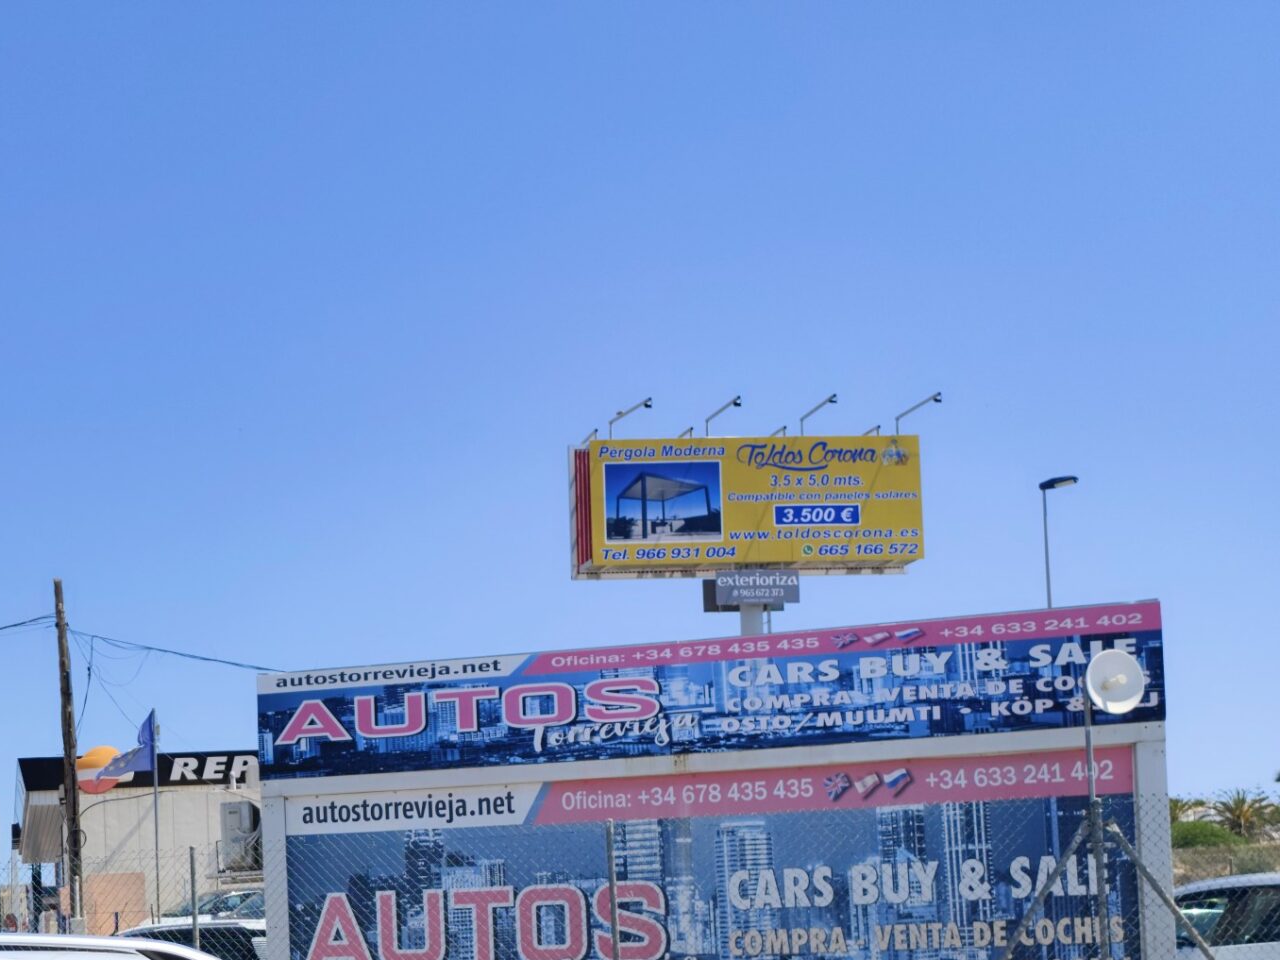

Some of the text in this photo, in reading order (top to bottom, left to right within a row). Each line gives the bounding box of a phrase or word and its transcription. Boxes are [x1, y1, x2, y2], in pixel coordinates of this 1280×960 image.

[598, 445, 725, 460] Pergola Moderna
[808, 441, 877, 464] Corona
[795, 476, 804, 486] x
[833, 475, 864, 486] mts.
[727, 490, 918, 502] Compatible con paneles solares
[782, 507, 853, 523] 3.500 €
[729, 527, 919, 540] www.toldoscorona.es
[601, 546, 736, 561] Tel. 966 931 004
[818, 543, 918, 557] 665 166 572
[718, 572, 798, 586] exterioriza
[939, 612, 1143, 639] +34 633 241 402
[551, 637, 820, 668] Oficina: +34 678 435 435
[275, 659, 501, 688] autostorrevieja.net
[727, 658, 841, 688] CARS
[858, 651, 953, 680] BUY
[974, 647, 1009, 671] &
[726, 690, 852, 713] COMPRA
[882, 682, 976, 702] VENTA
[985, 678, 1024, 696] DE
[990, 695, 1054, 718] KÖP
[274, 677, 661, 746] AUTOS
[925, 768, 967, 790] +34
[973, 765, 1017, 787] 633
[1023, 762, 1065, 784] 241
[301, 791, 516, 824] autostorrevieja.net
[561, 777, 814, 811] Oficina: +34 678 435 435
[729, 852, 1110, 911] CARS BUY & SALE
[729, 926, 849, 957] COMPRA
[874, 921, 963, 951] VENTA
[972, 919, 1008, 949] DE
